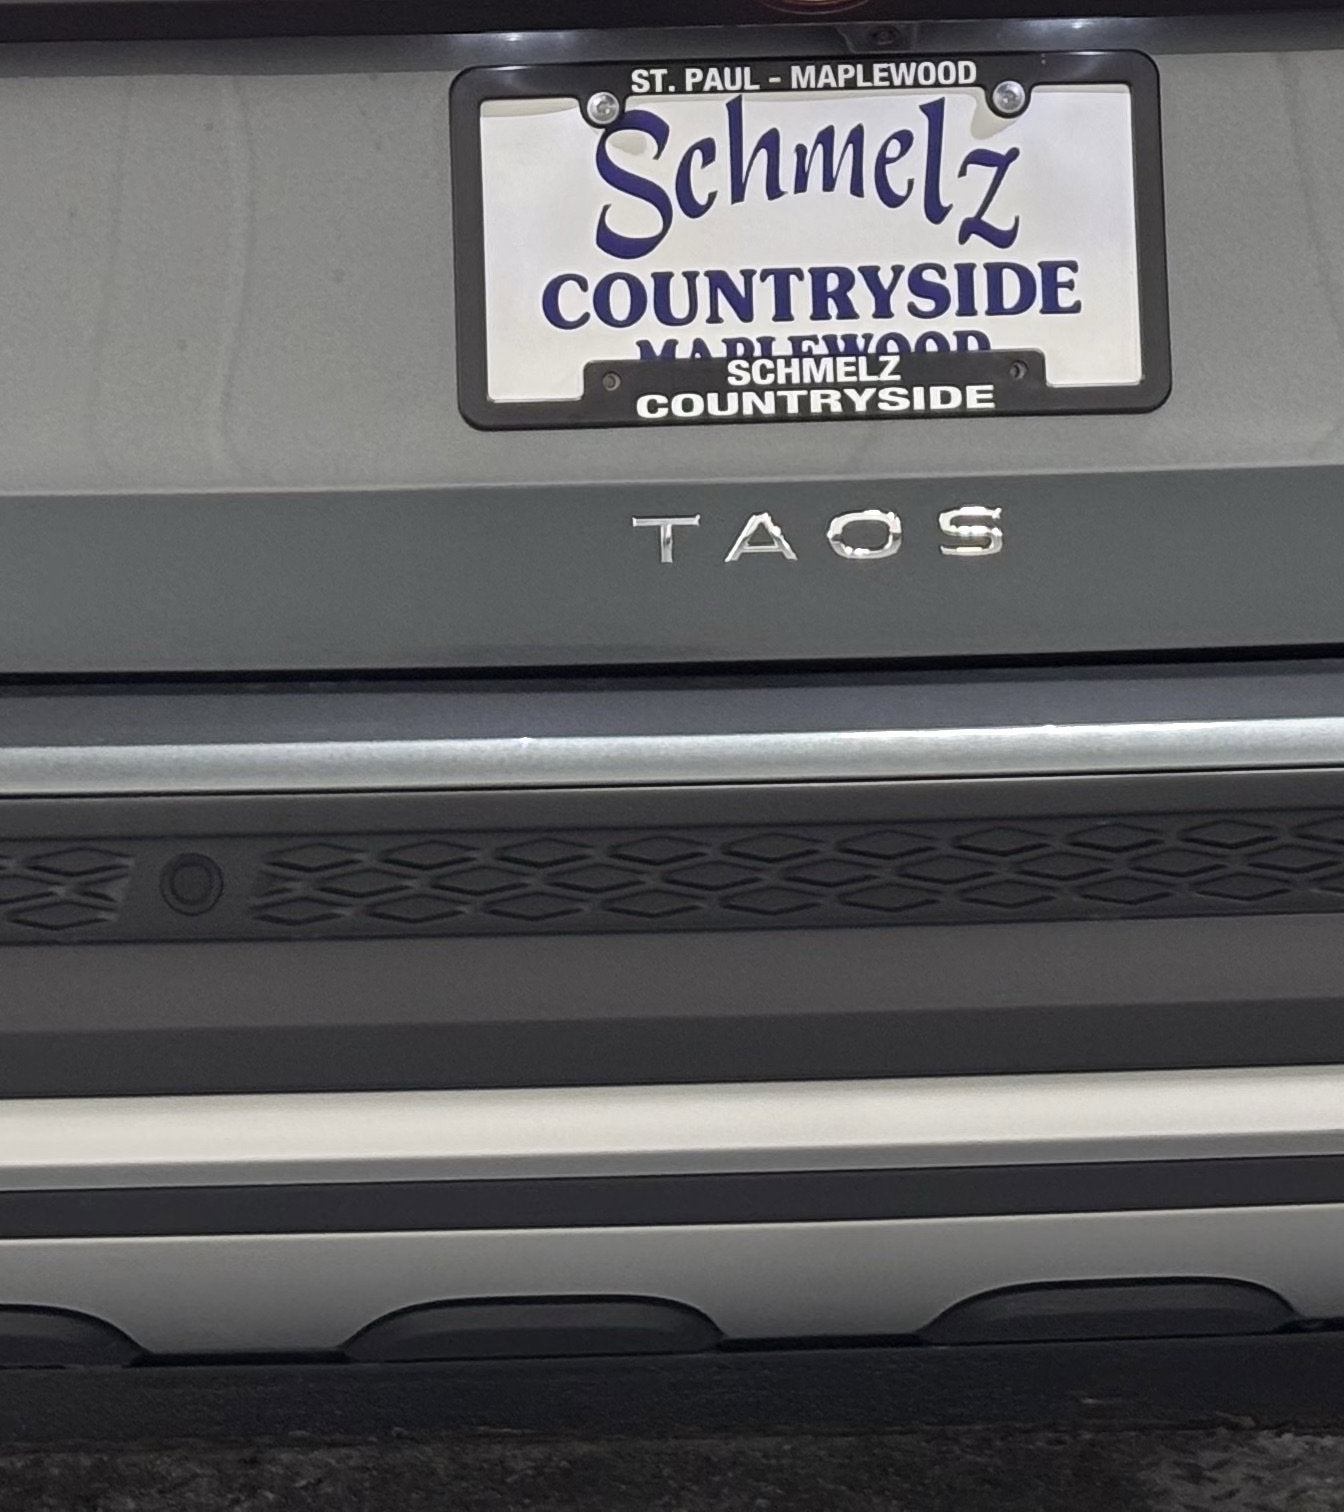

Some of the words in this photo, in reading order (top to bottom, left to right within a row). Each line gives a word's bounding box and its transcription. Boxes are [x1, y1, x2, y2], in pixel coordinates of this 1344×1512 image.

[630, 68, 676, 94] ST.
[684, 66, 761, 92] PAUL
[790, 60, 978, 90] MAPLEWOOD
[595, 94, 1022, 261] Schmelz
[541, 260, 1083, 331] COUNTRYSIDE
[726, 355, 902, 386] SCHMELZ
[635, 384, 996, 419] COUNTRYSIDE
[632, 506, 1004, 564] TAOS
